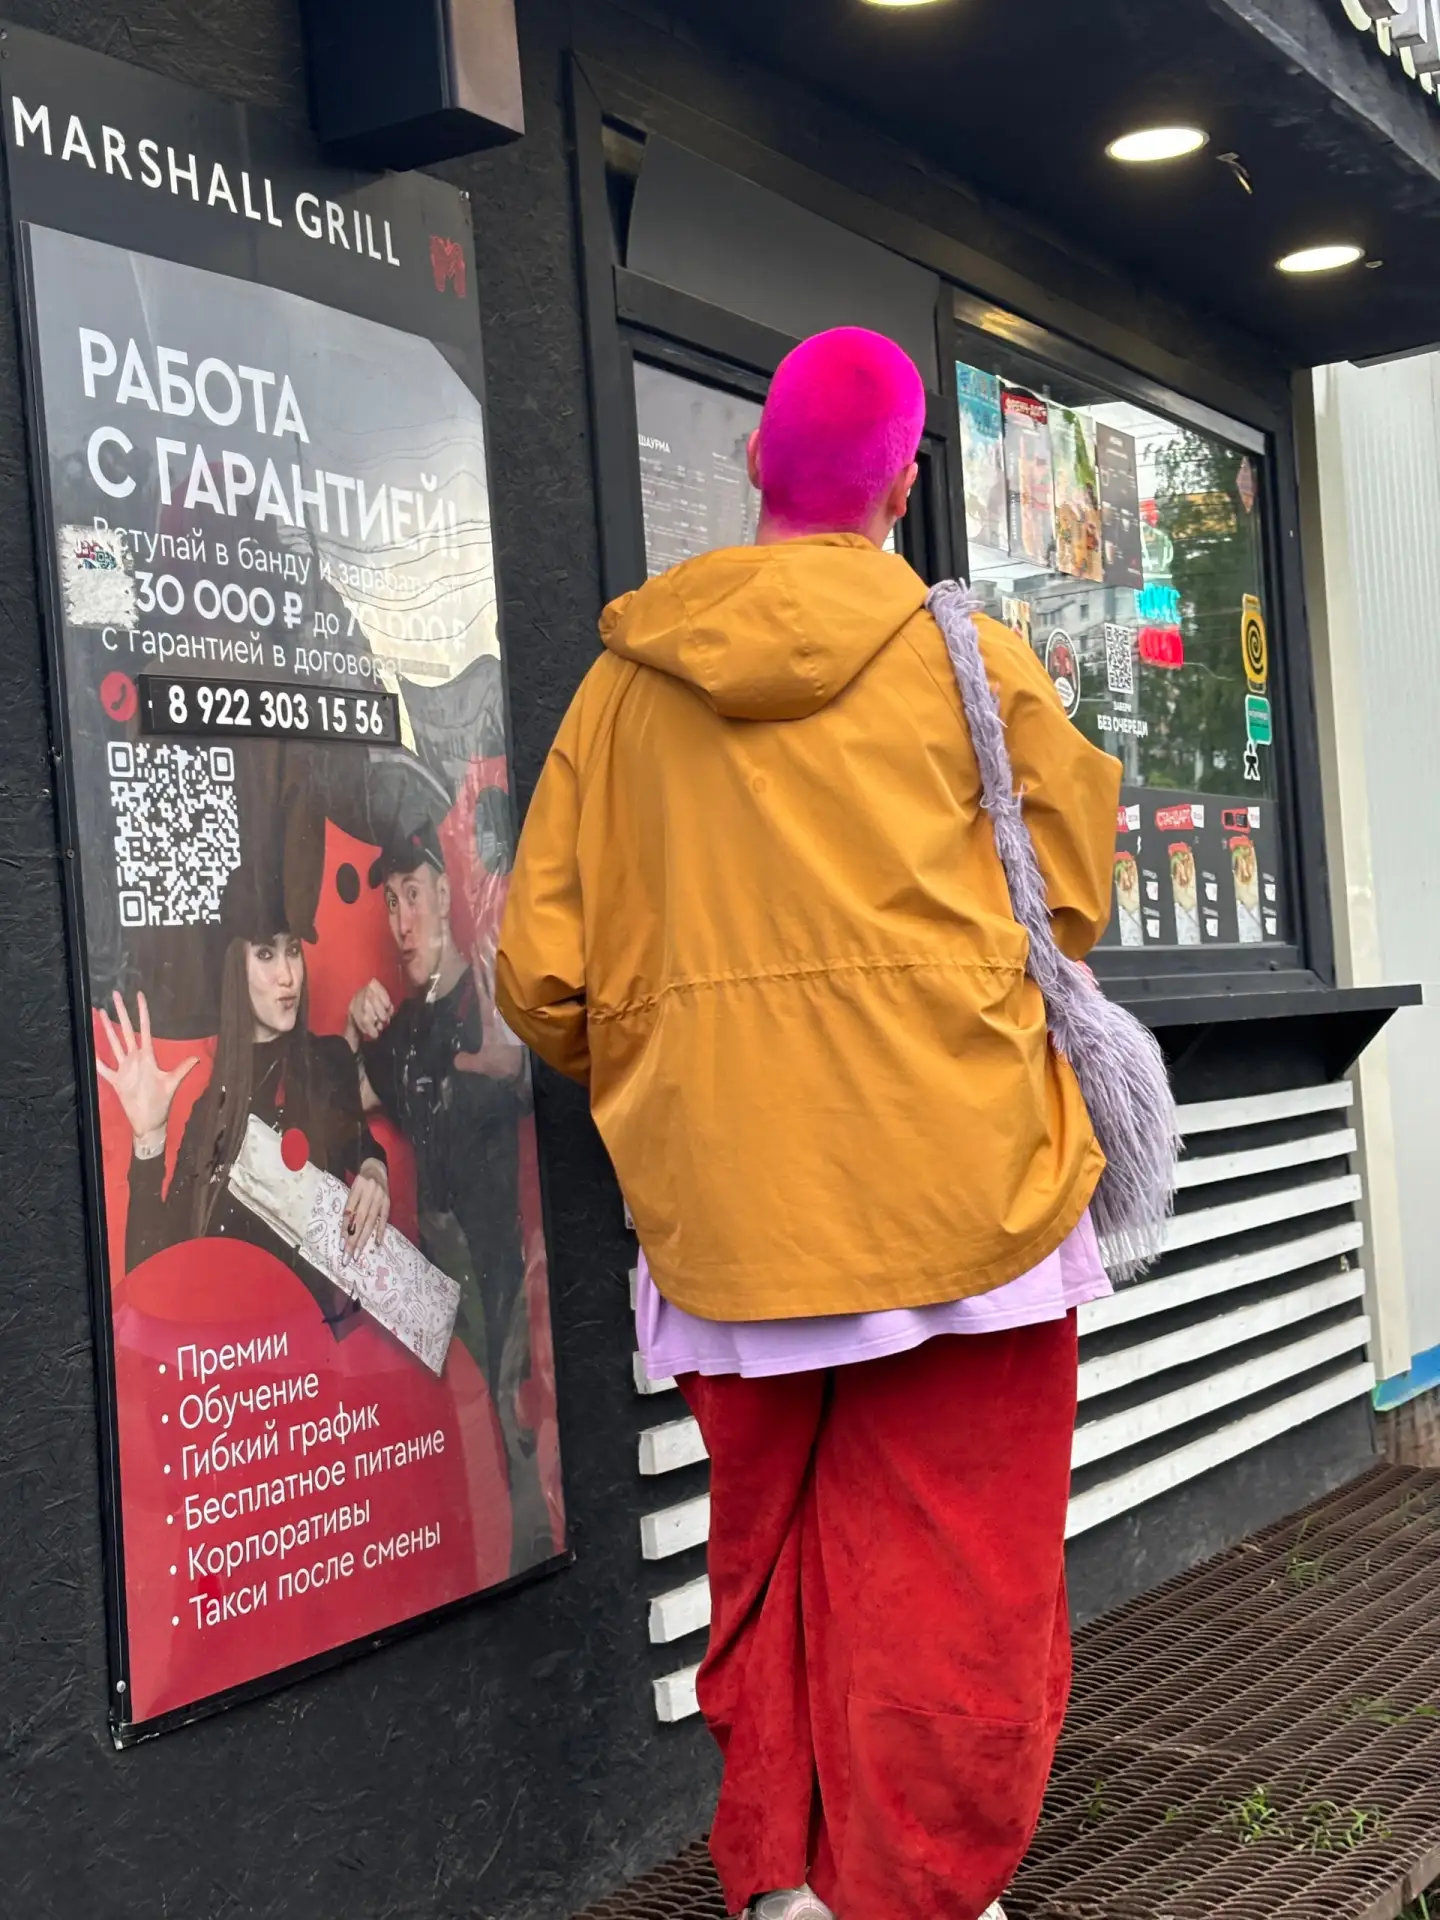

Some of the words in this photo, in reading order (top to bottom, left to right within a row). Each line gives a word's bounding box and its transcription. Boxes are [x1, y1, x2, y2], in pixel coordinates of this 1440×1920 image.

[12, 95, 283, 228] MARSHALL
[295, 192, 401, 267] GRILL
[78, 326, 311, 444] РАБОТА
[87, 426, 137, 499] С
[156, 437, 460, 560] ГАРАНТИЕЙ!
[216, 542, 230, 566] в
[238, 537, 311, 585] банду
[319, 559, 332, 582] и
[134, 571, 185, 615] 30
[194, 579, 276, 627] 000
[313, 610, 340, 639] до
[102, 626, 118, 651] с
[128, 629, 265, 665] гарантией
[273, 644, 286, 667] в
[168, 685, 188, 724] 8
[197, 686, 252, 726] 922
[260, 690, 310, 730] 303
[317, 696, 348, 733] 15
[355, 699, 383, 735] 56
[176, 1331, 289, 1384] Премии
[179, 1371, 320, 1429] Обучение
[182, 1422, 279, 1480] Гибкий
[289, 1401, 381, 1455] график
[184, 1461, 346, 1531] Бесплатное
[354, 1427, 446, 1480] питание
[188, 1498, 371, 1581] Корпоративы
[189, 1580, 268, 1630] Такси
[277, 1550, 355, 1601] после
[363, 1520, 442, 1569] смены
